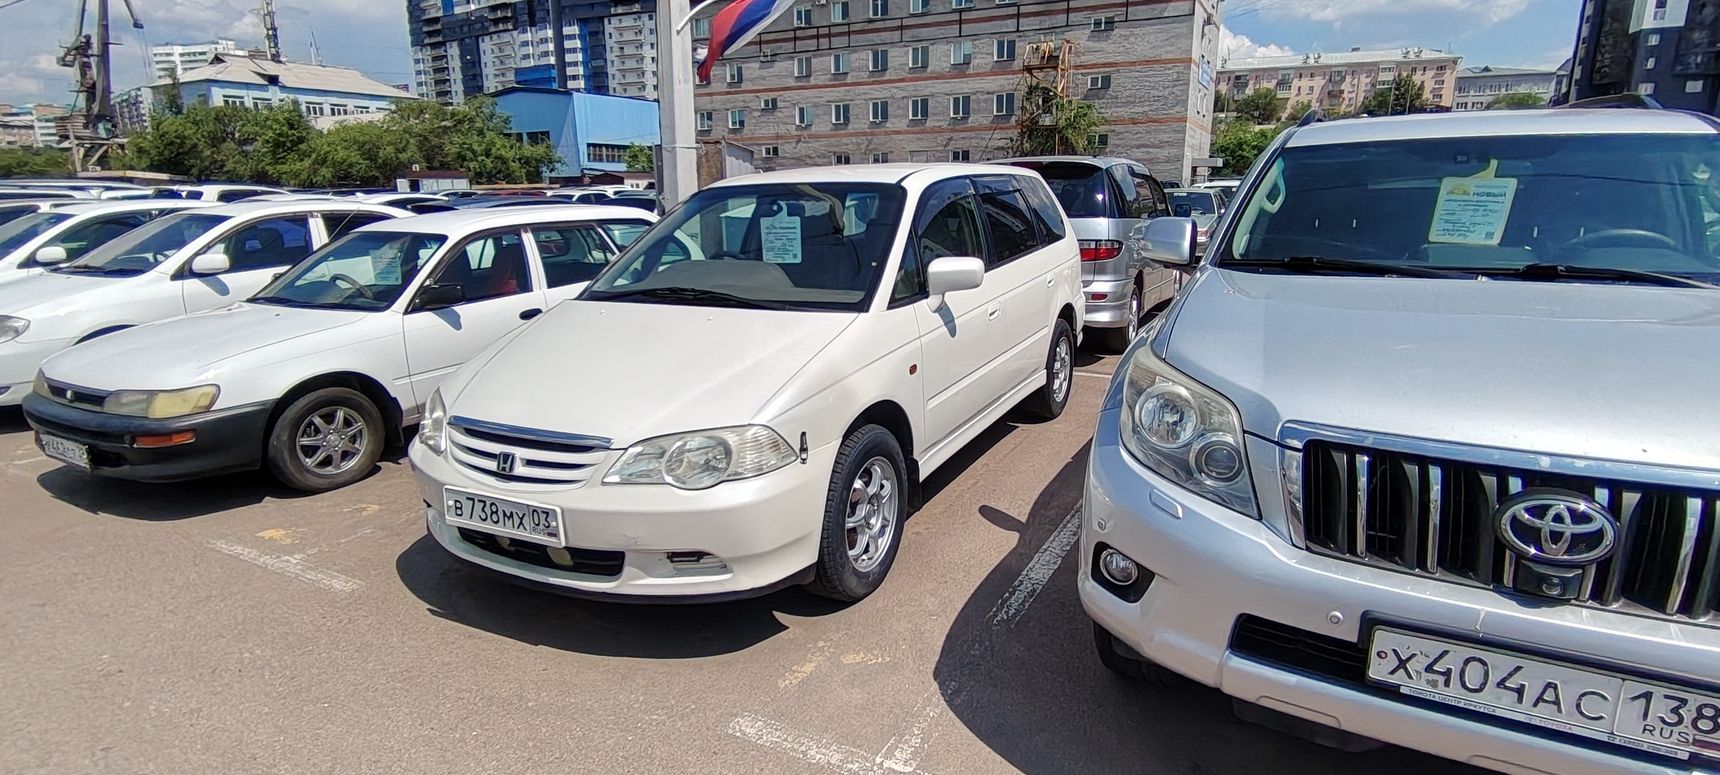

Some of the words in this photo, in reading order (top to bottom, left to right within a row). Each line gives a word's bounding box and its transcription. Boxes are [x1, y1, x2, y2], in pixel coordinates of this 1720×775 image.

[531, 508, 551, 529] 03
[532, 526, 547, 536] RUS
[1628, 690, 1720, 735] 138
[1642, 724, 1690, 744] RUS
